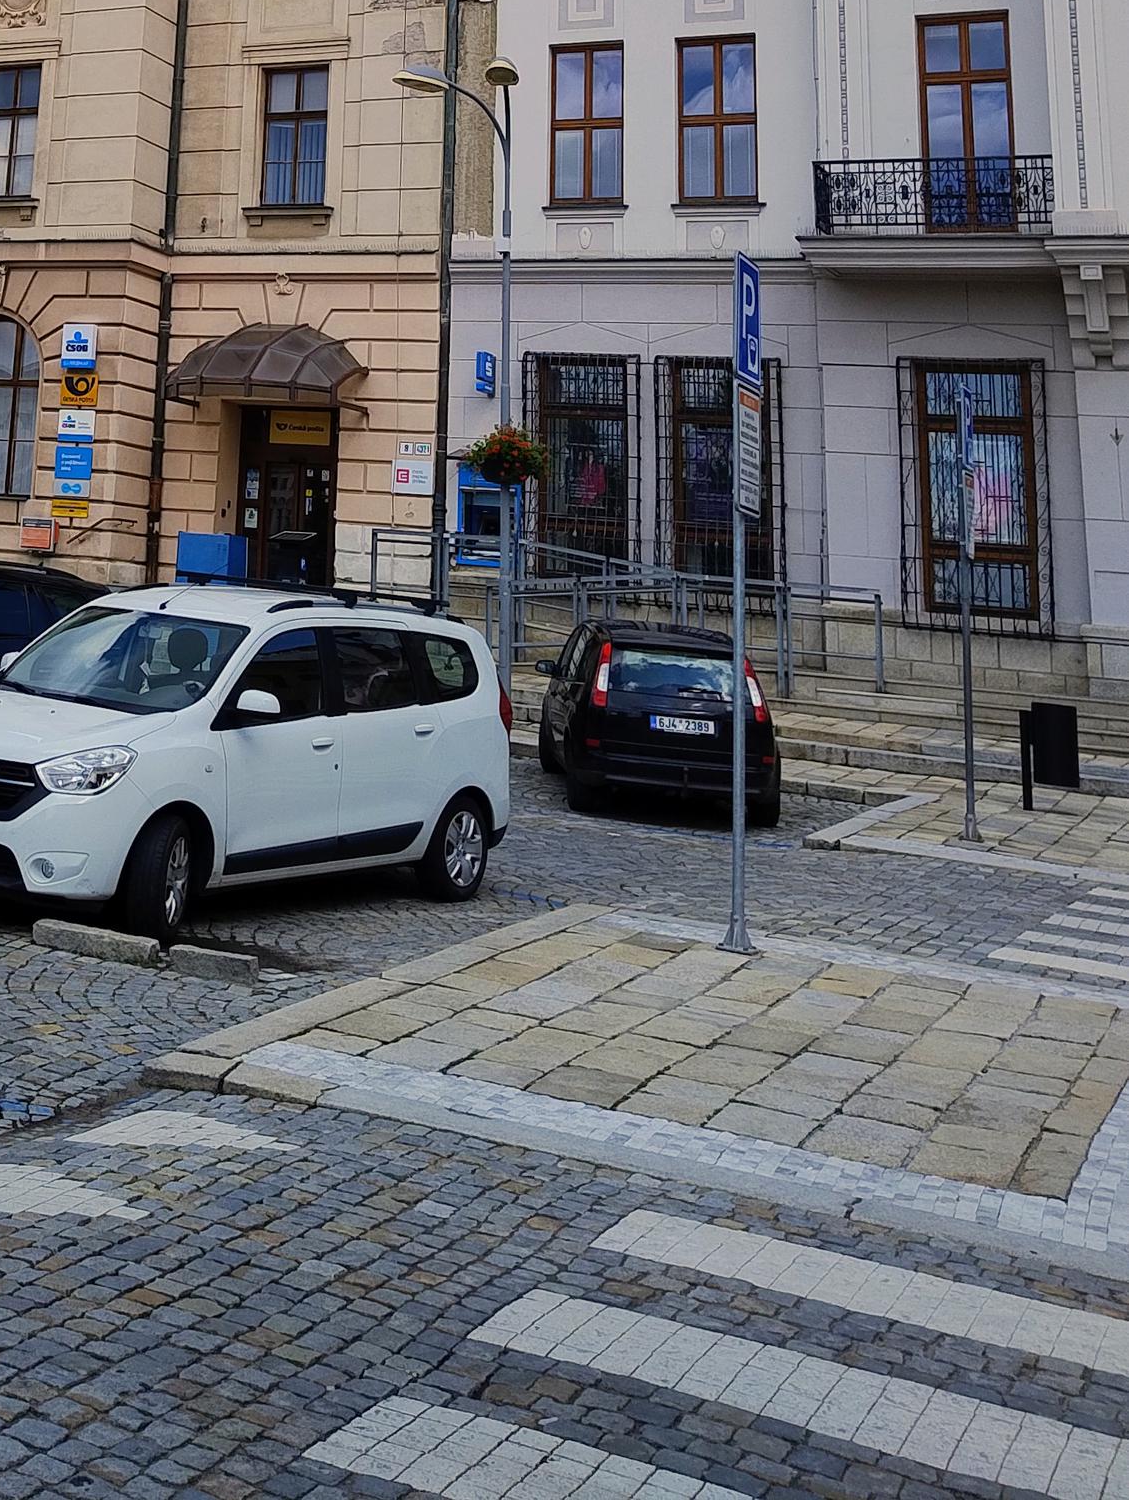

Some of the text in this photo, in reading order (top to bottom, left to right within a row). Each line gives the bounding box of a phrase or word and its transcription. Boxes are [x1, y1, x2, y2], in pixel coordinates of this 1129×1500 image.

[742, 271, 756, 340] P
[658, 717, 710, 732] 6J4 2389
